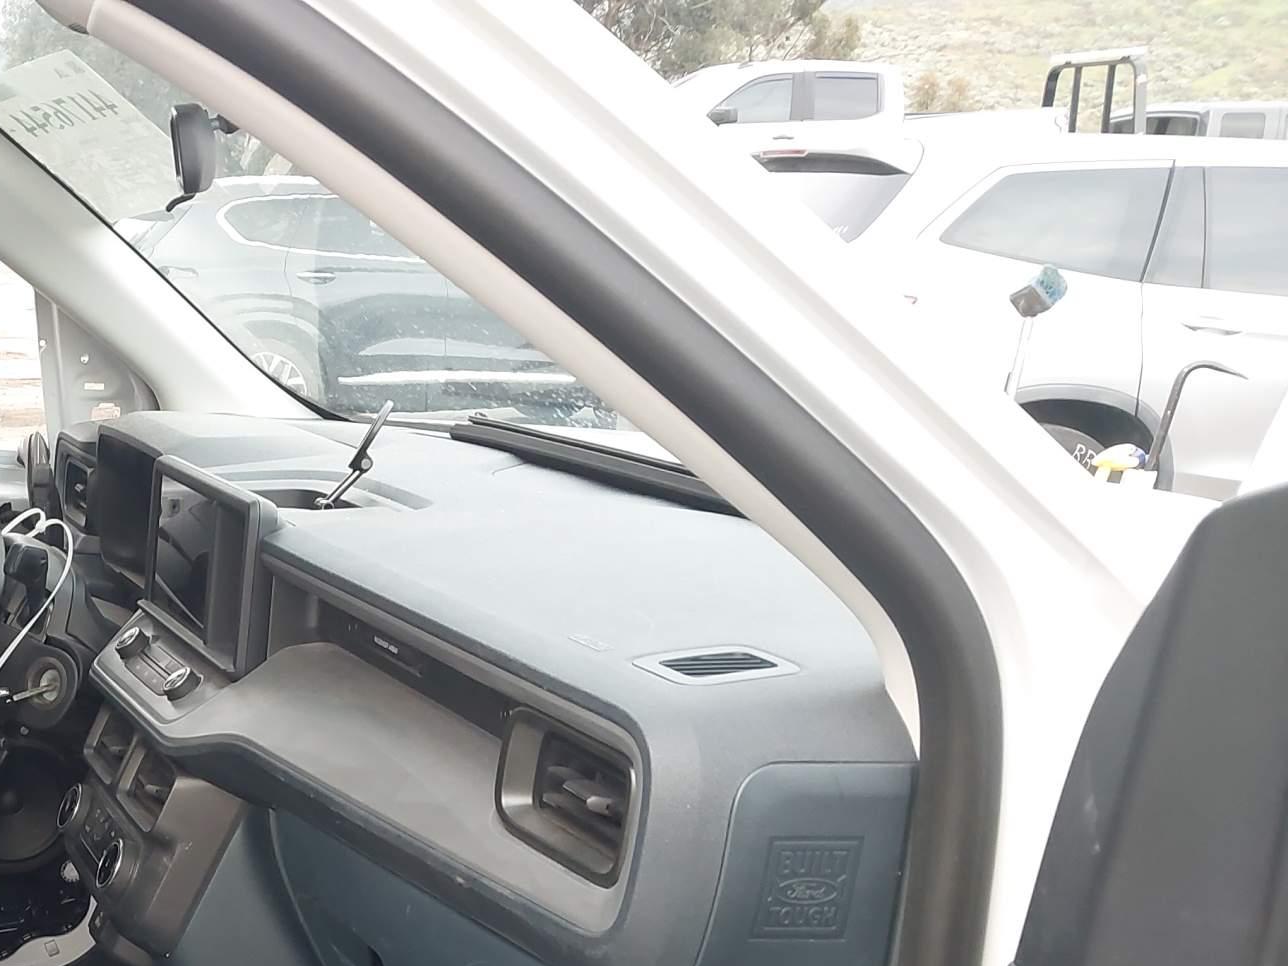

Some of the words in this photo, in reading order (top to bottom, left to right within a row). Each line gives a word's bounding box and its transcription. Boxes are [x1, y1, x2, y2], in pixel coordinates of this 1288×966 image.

[779, 850, 849, 873] BUILT
[785, 881, 828, 900] Ford
[768, 906, 838, 925] TOUGH
